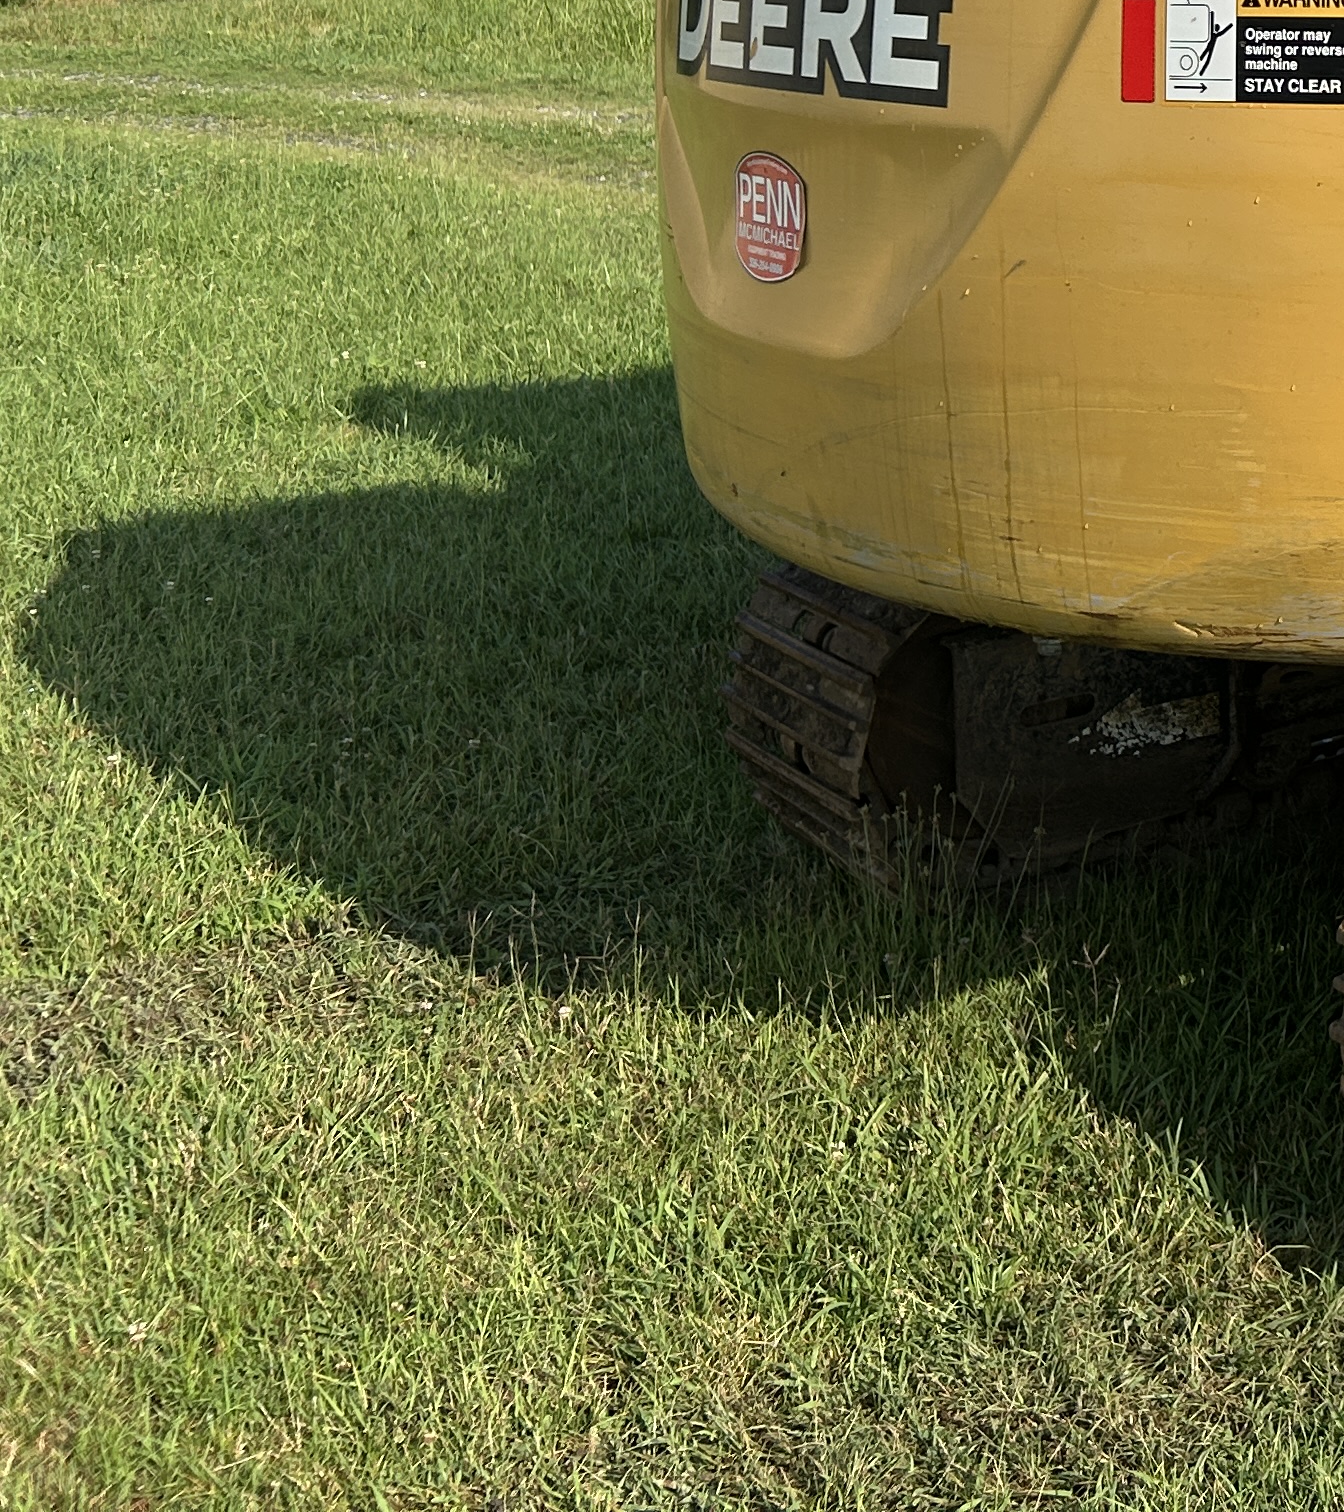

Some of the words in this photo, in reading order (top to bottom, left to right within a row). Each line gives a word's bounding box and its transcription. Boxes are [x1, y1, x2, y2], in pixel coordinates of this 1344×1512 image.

[1244, 28, 1301, 43] Operator
[1302, 30, 1332, 44] may
[1244, 43, 1282, 58] swing
[1284, 45, 1299, 56] or
[1244, 58, 1298, 70] machine
[1244, 78, 1285, 93] STAY
[1287, 78, 1342, 94] CLEAR
[738, 172, 801, 231] PENN
[738, 220, 800, 251] MCMICHAEL
